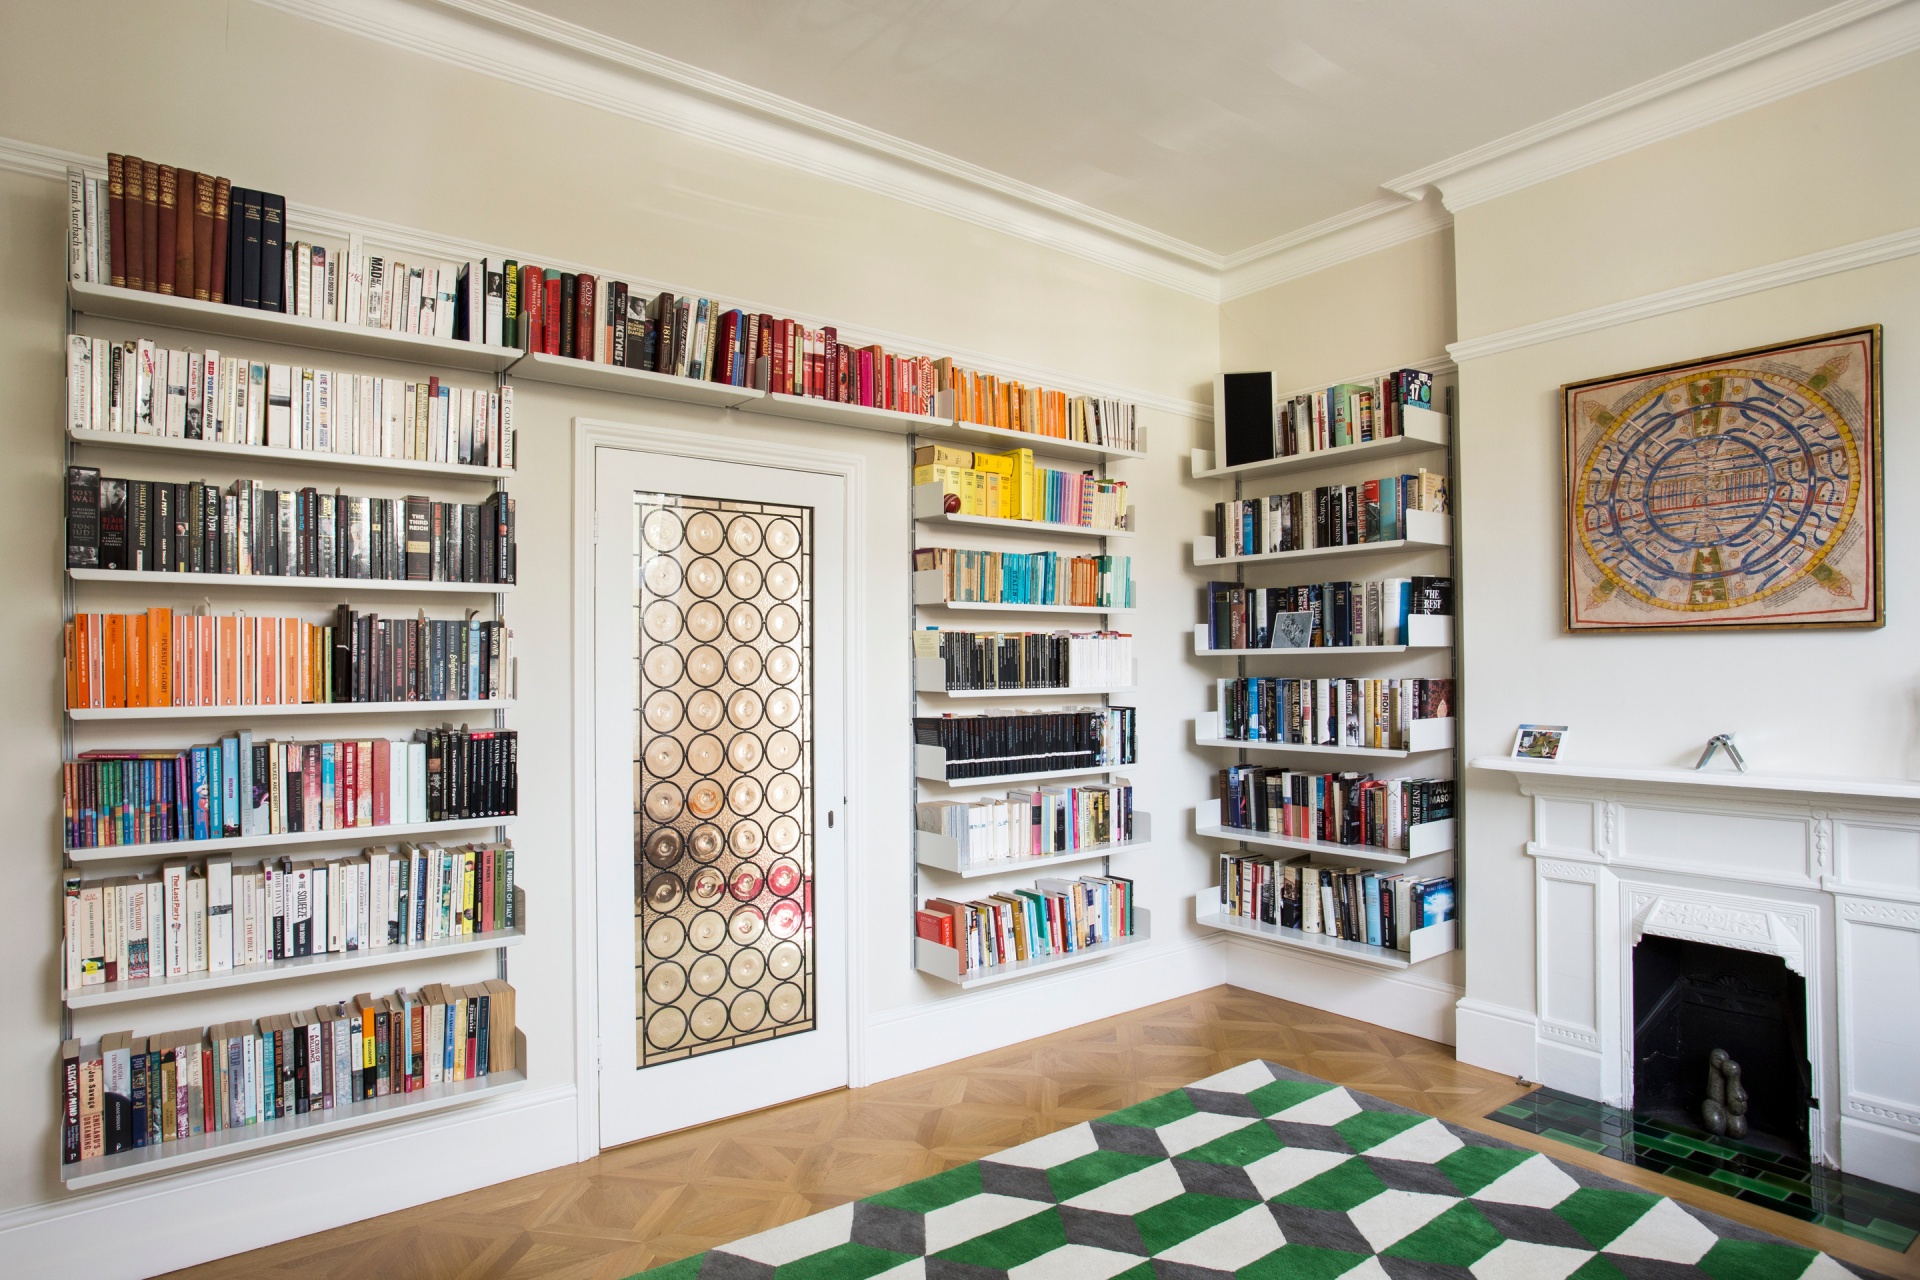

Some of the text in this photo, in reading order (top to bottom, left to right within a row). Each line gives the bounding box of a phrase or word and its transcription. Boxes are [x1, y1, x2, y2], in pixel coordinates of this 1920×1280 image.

[72, 180, 82, 246] Frank Auerbach
[371, 257, 383, 278] MAD
[616, 325, 624, 360] KEYNES
[727, 340, 735, 376] HERMITAGE
[1410, 384, 1419, 400] 17
[1318, 496, 1327, 524] Strategy
[1424, 600, 1441, 608] REST
[1425, 590, 1440, 598] THE
[448, 654, 457, 691] Enlightenment
[135, 893, 144, 931] Millennium
[298, 891, 307, 918] SQUEEZE
[337, 1027, 345, 1055] AFRICA
[412, 1017, 422, 1048] POMPEII
[231, 1052, 240, 1066] TOUR
[68, 1064, 78, 1117] SLEIGHTS MIND
